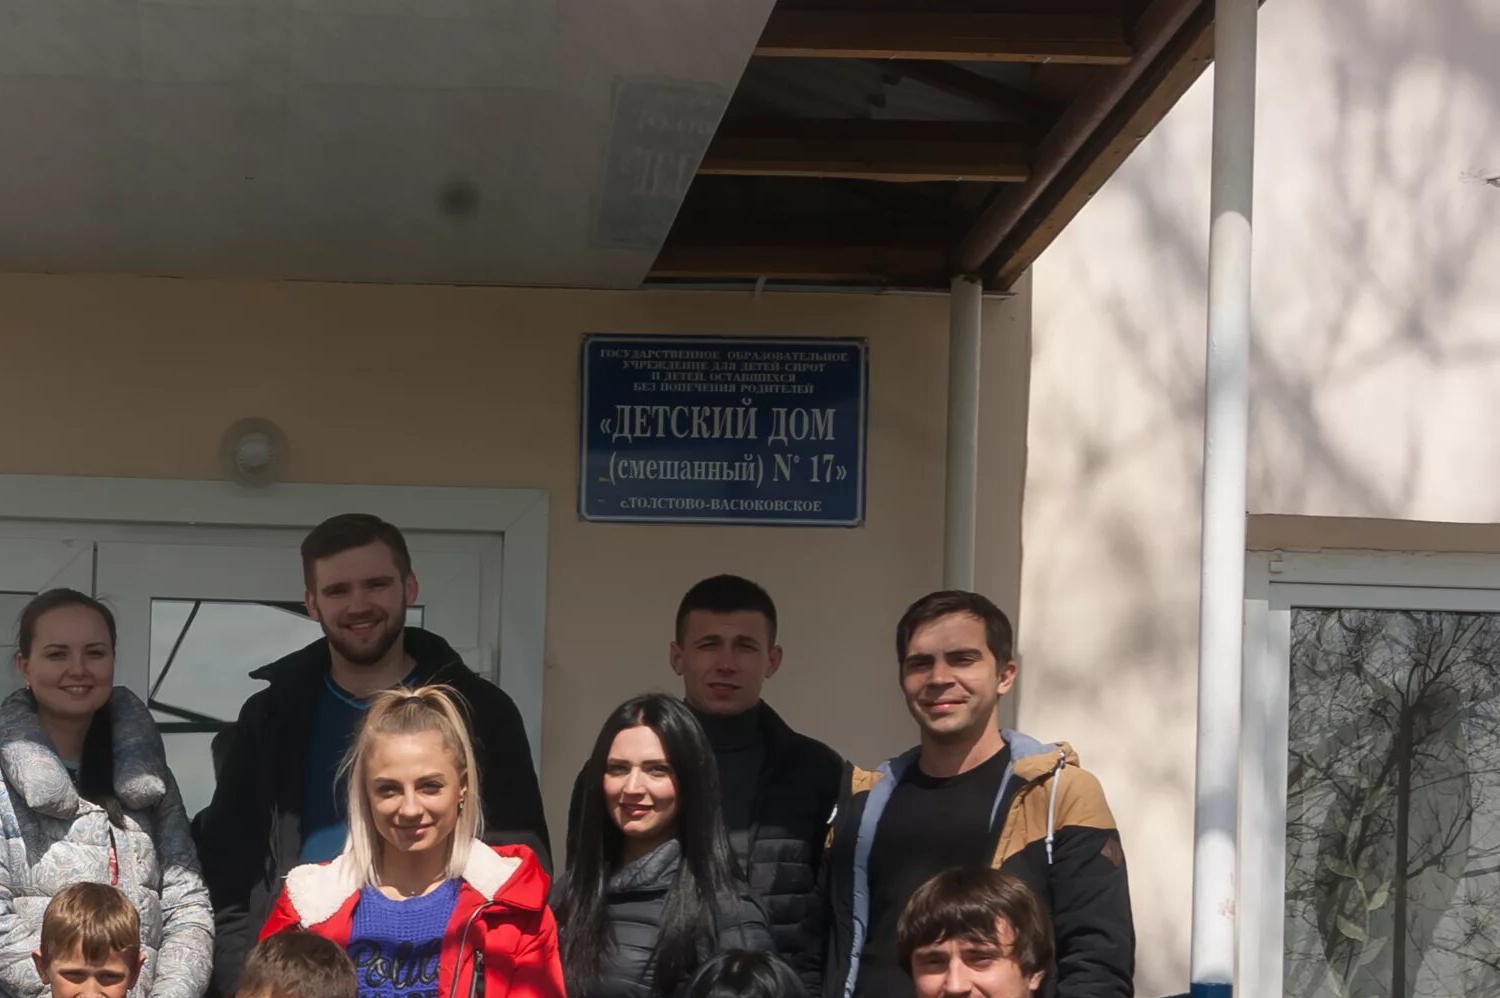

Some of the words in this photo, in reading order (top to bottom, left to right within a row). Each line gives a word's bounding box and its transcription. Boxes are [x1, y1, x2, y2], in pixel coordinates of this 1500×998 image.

[600, 349, 721, 361] ГОСУДАРСТВЕННОЕ
[727, 350, 849, 362] ОБРАЗОВАТЕЛЬНОЕ
[622, 360, 708, 371] УЧРЕЖДЕНИЕ
[711, 361, 736, 372] ДЛЯ
[651, 372, 660, 381] И
[709, 372, 796, 383] ОСТАВШИХСЯ
[633, 382, 656, 392] БЕЗ
[660, 383, 736, 393] ПОПЕЧЕНИЯ
[740, 381, 815, 394] РОДИТЕЛЕЙ
[767, 408, 836, 446] ДОМ
[609, 451, 764, 488] (смешанный)
